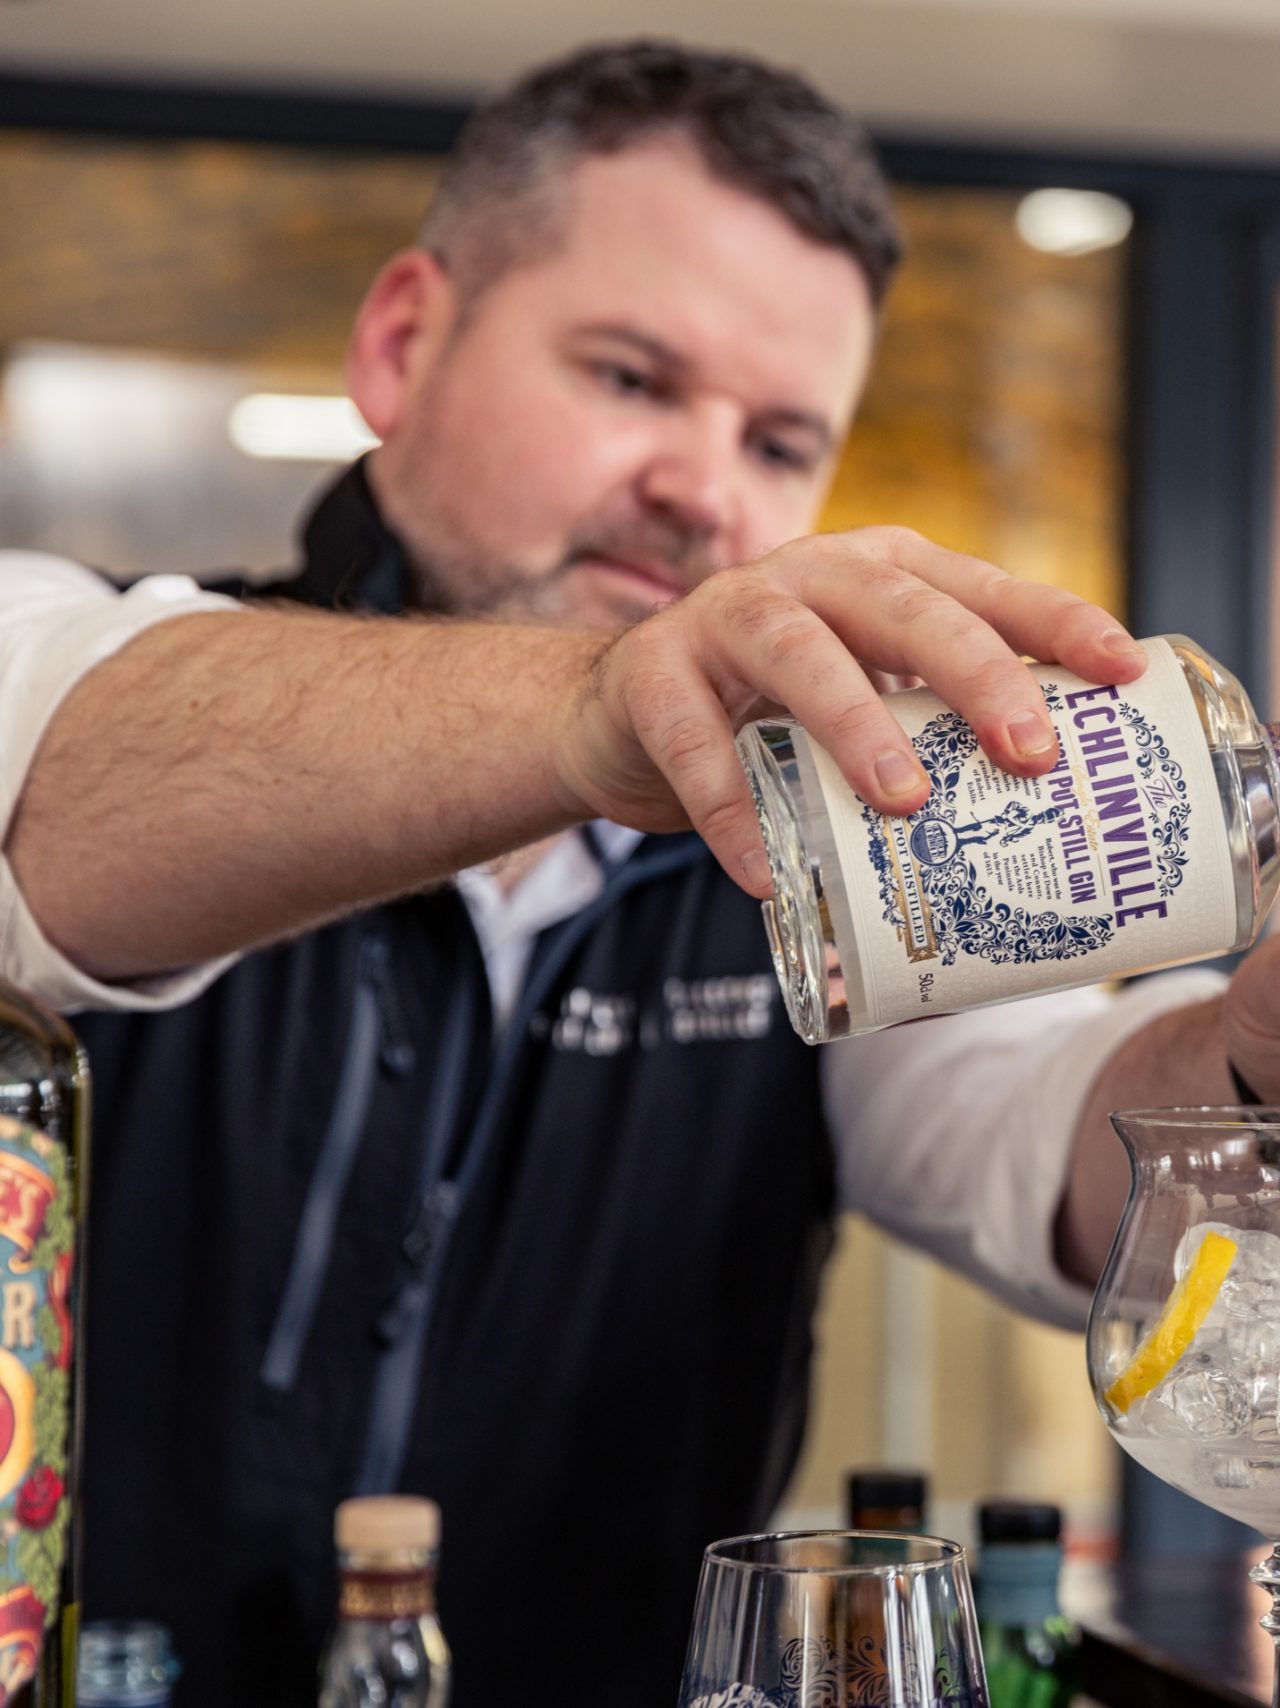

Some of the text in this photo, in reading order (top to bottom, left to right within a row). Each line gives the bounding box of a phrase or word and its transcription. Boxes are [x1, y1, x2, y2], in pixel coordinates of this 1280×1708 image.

[975, 777, 986, 801] Robert
[978, 760, 991, 790] grandson
[1048, 775, 1080, 811] POT
[1064, 685, 1168, 928] ECHLINVILLE
[1144, 777, 1174, 810] The
[1045, 837, 1056, 862] Robert,
[1057, 815, 1090, 870] STILL
[1003, 857, 1014, 892] Peninsula
[1021, 854, 1031, 880] settled
[1030, 853, 1042, 900] and Connor,
[1037, 845, 1047, 870] Bishop
[1044, 880, 1052, 900] Down
[893, 826, 908, 857] POT
[901, 862, 926, 945] DISTILLED
[1068, 870, 1097, 905] GIN
